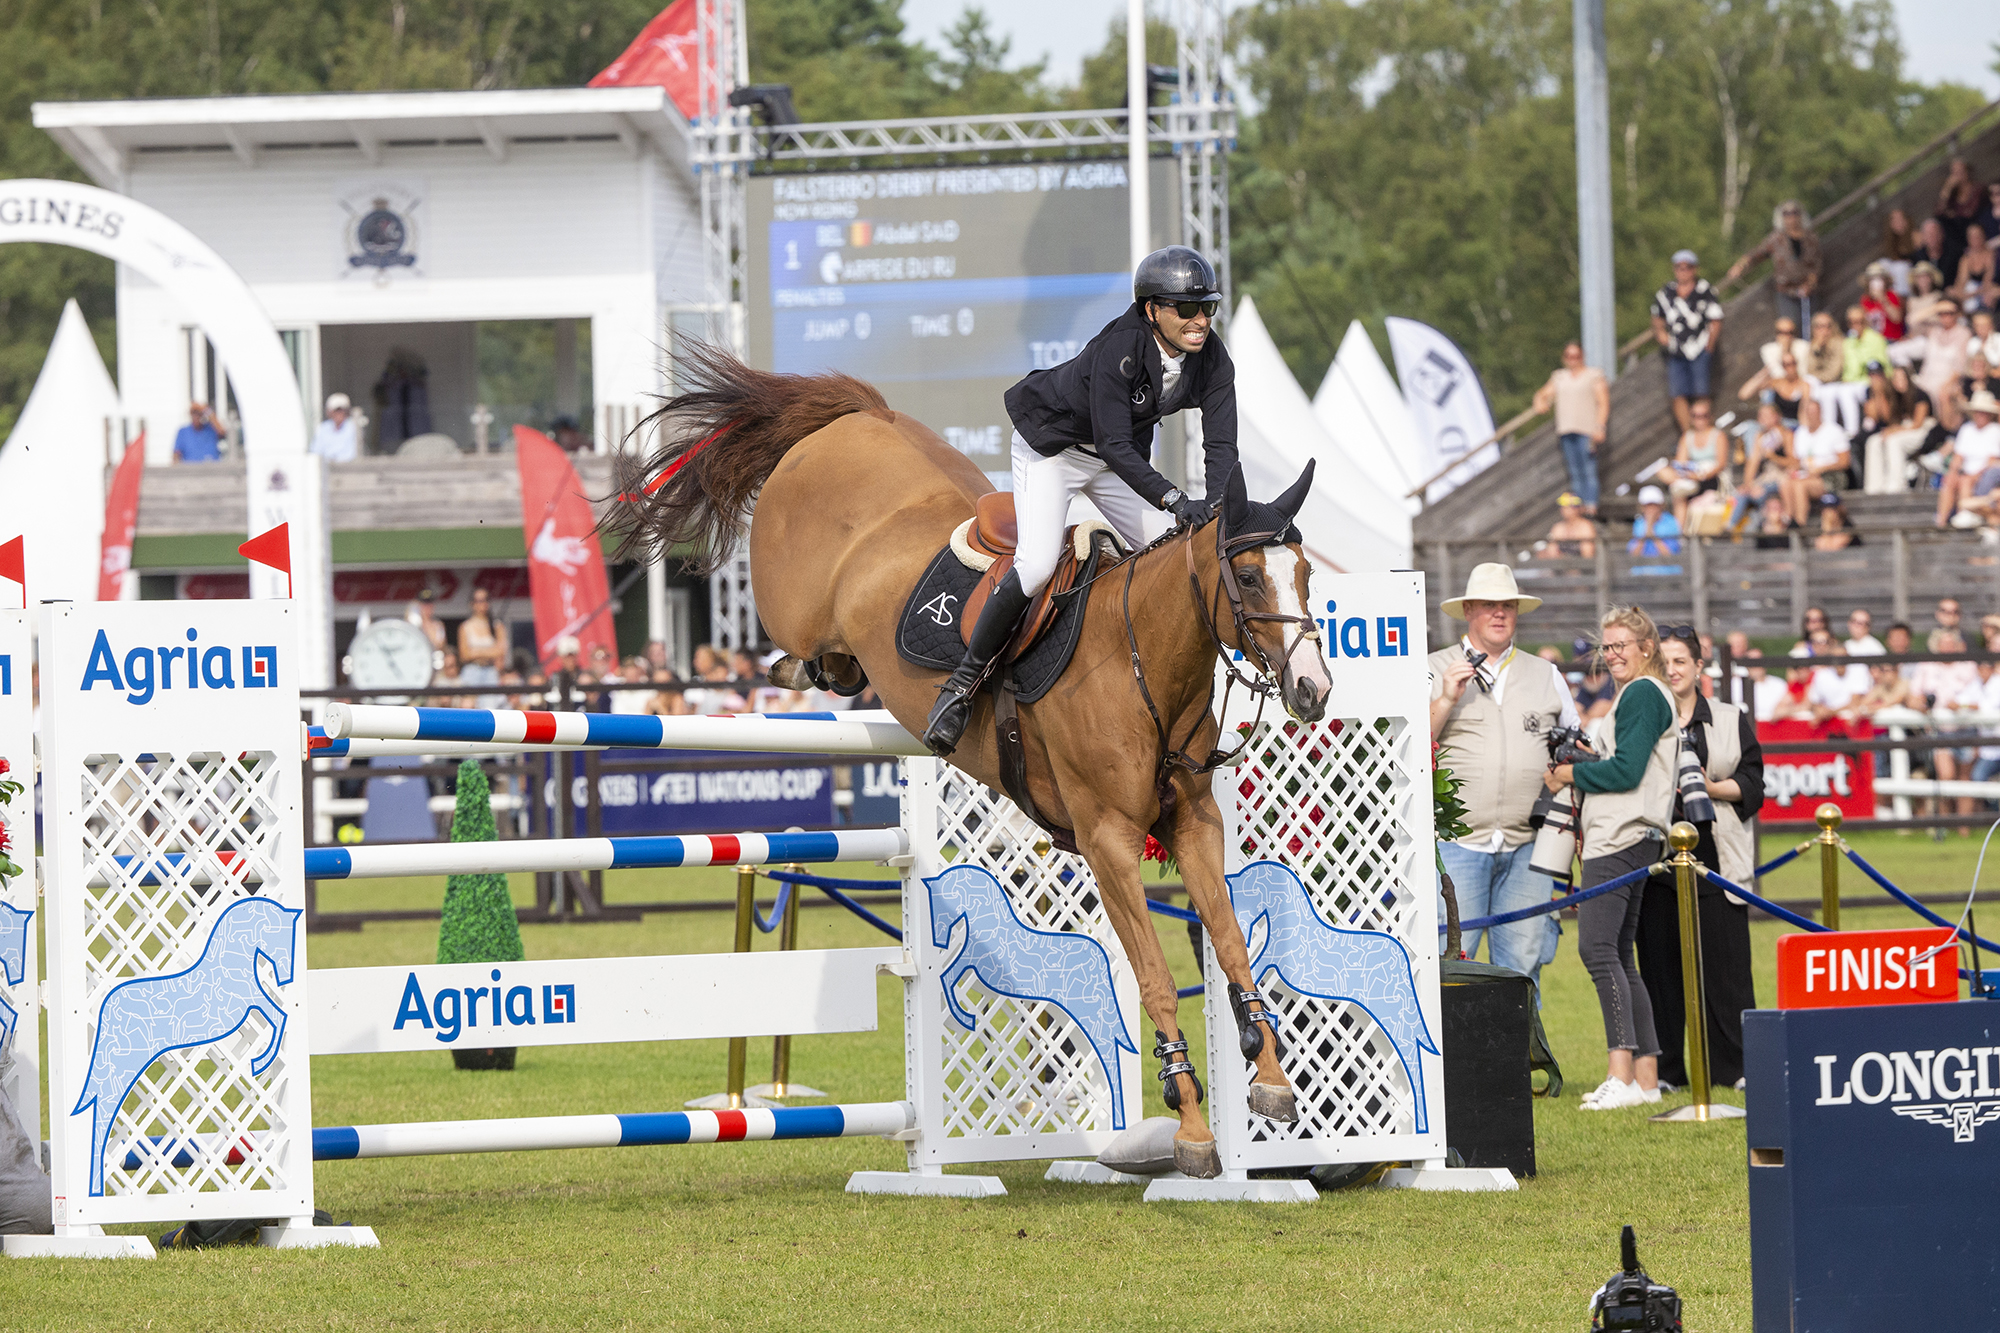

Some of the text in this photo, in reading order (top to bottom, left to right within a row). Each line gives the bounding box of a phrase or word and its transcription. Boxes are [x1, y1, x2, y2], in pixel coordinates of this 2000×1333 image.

[877, 171, 934, 198] DERBY
[936, 167, 1037, 195] PRESENTED
[1039, 165, 1064, 191] BY
[1064, 163, 1128, 190] AGRIA
[785, 240, 801, 270] 1
[803, 318, 849, 341] JUMP
[910, 314, 951, 337] TIME
[944, 426, 1002, 455] TIME
[80, 628, 235, 705] Agria
[699, 770, 780, 804] NATIONS
[781, 768, 824, 801] CUP
[1806, 946, 1935, 993] FINISH
[393, 968, 536, 1043] Agria
[1814, 1046, 2000, 1106] LONGI
